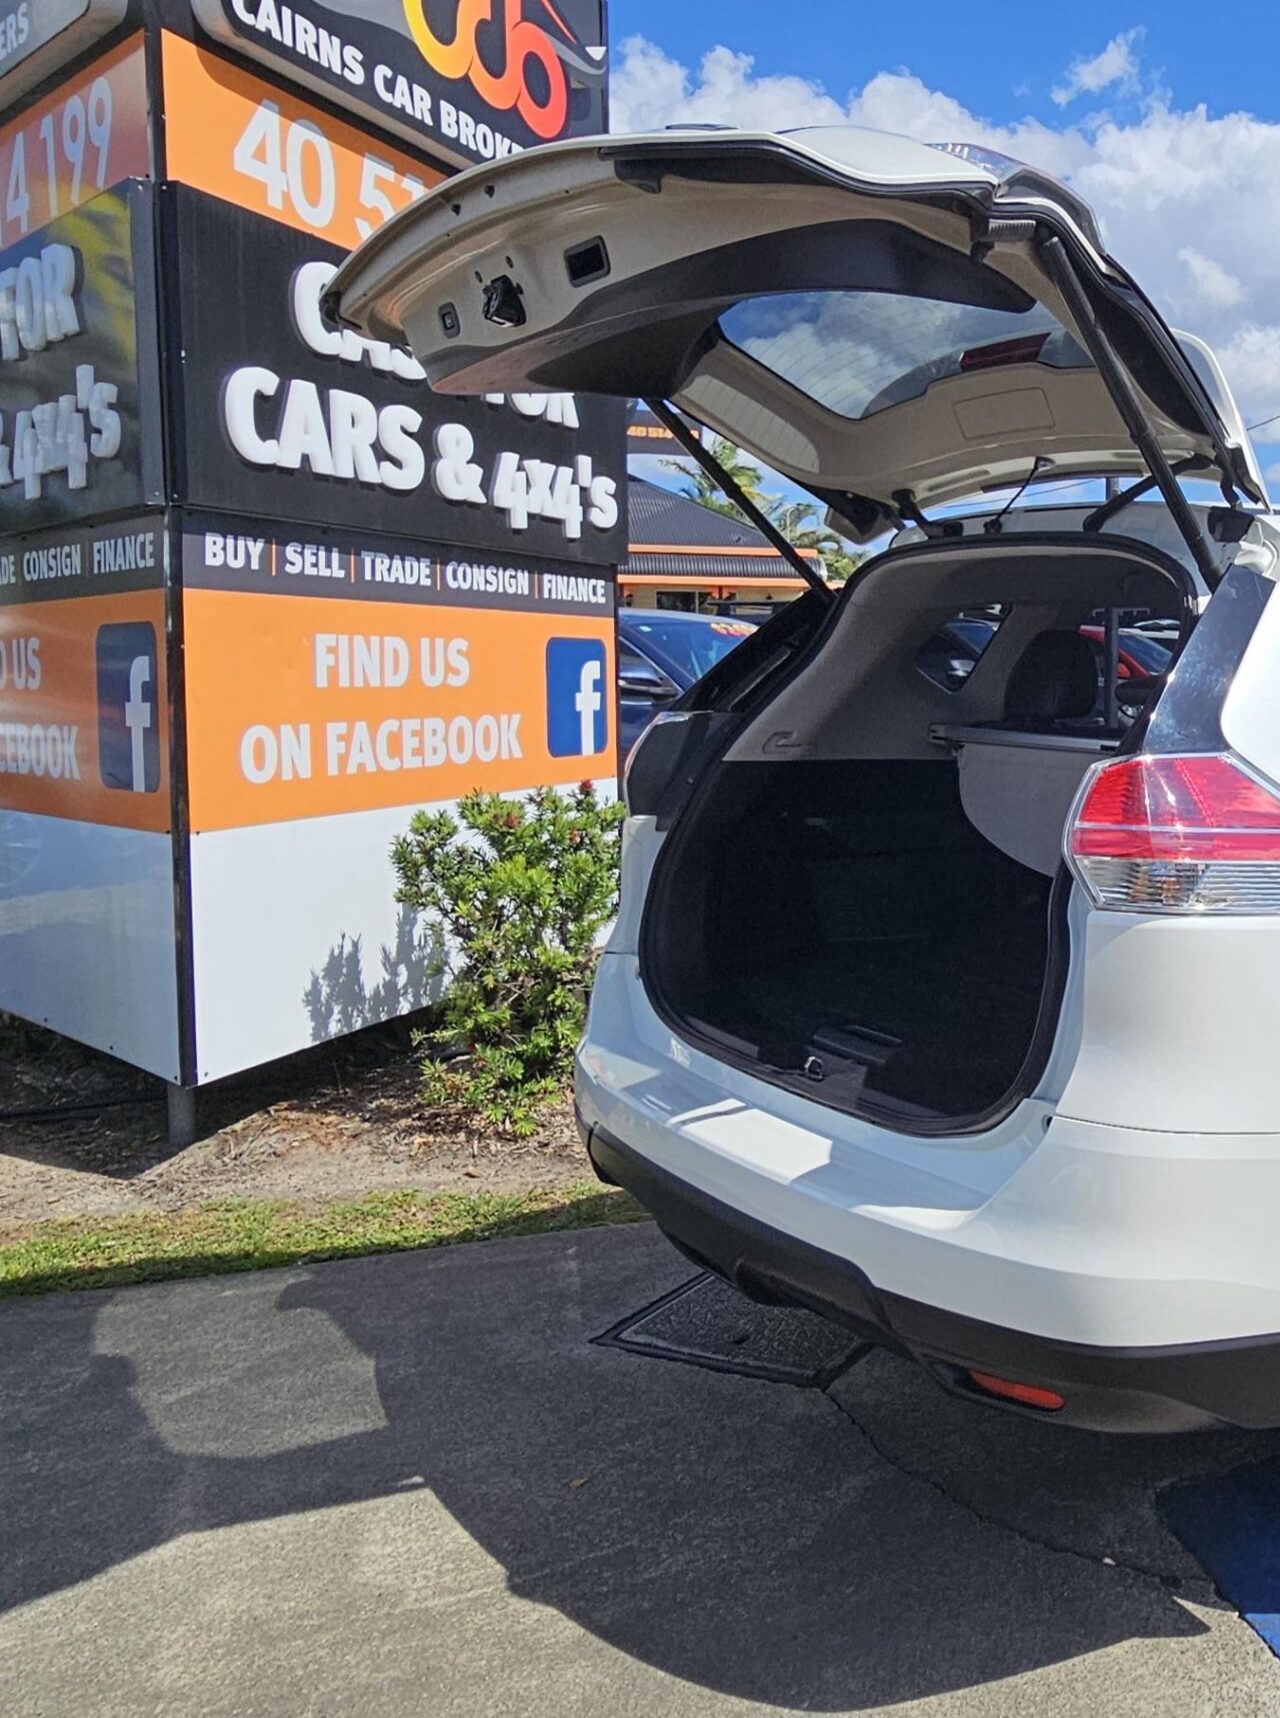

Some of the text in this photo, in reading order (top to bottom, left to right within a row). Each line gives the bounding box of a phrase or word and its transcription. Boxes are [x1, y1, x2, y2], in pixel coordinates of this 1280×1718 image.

[231, 0, 525, 161] CAIRNS CAR BROK
[233, 98, 425, 242] 40 5
[224, 366, 426, 491] CARS
[434, 422, 488, 504] &
[0, 532, 155, 585] DE CONSIGN FINANCE
[204, 531, 607, 605] BUY SELL TRADE CONSIGN FINANCE
[12, 636, 42, 691] US
[314, 633, 471, 689] FIND US
[239, 713, 523, 784] ON FACEBOOK
